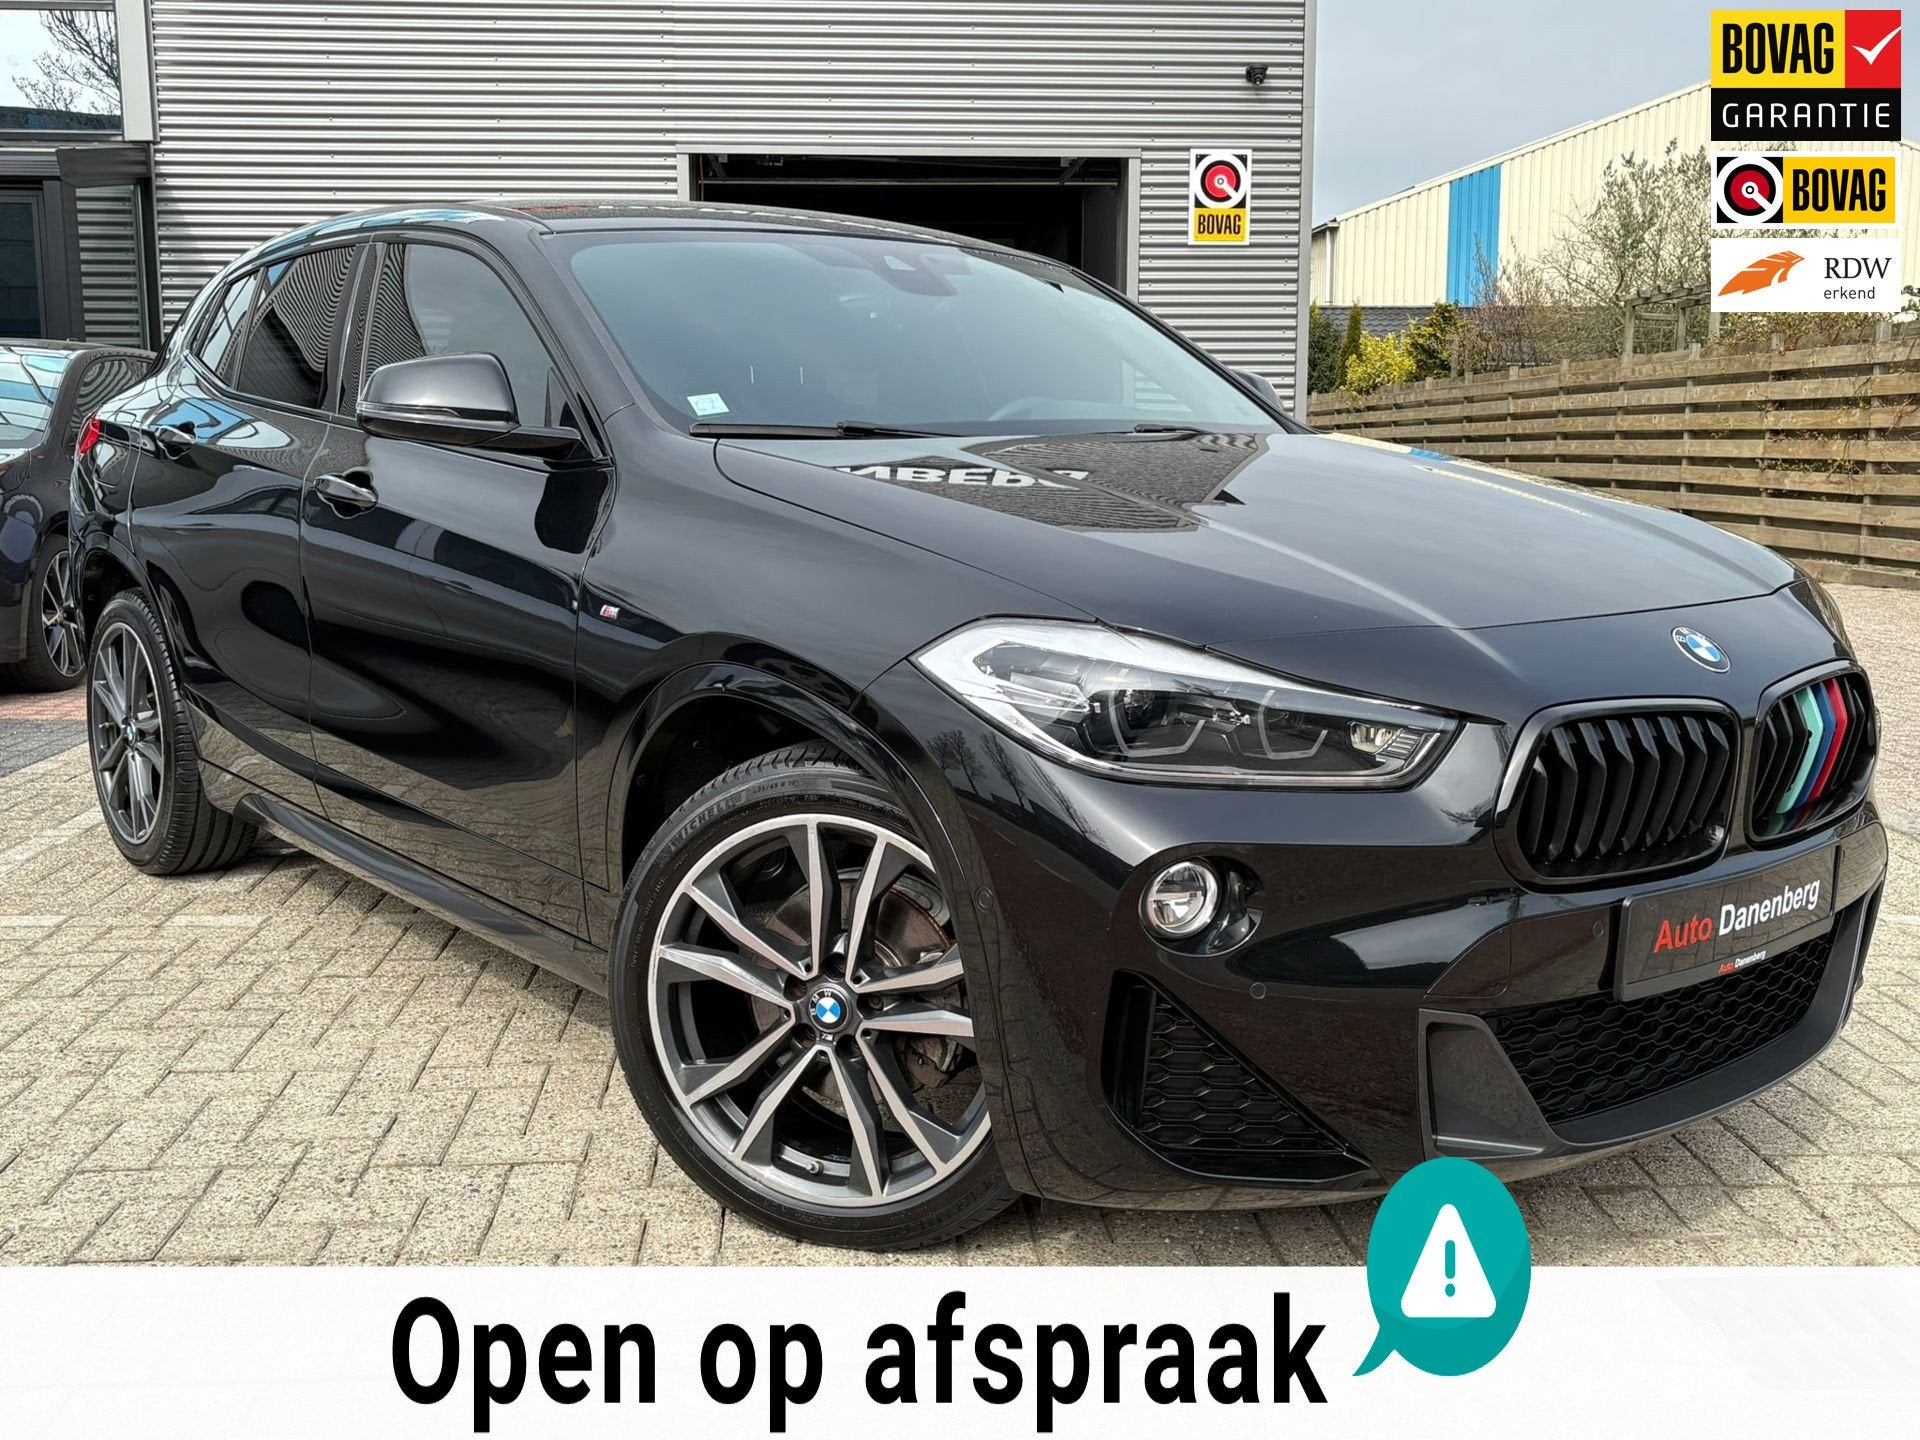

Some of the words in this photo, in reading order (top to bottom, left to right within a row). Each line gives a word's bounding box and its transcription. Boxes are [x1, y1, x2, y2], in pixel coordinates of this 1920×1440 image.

[1197, 213, 1242, 235] BOVAG
[1653, 914, 1713, 953] Auto
[1719, 879, 1821, 936] Danenberg
